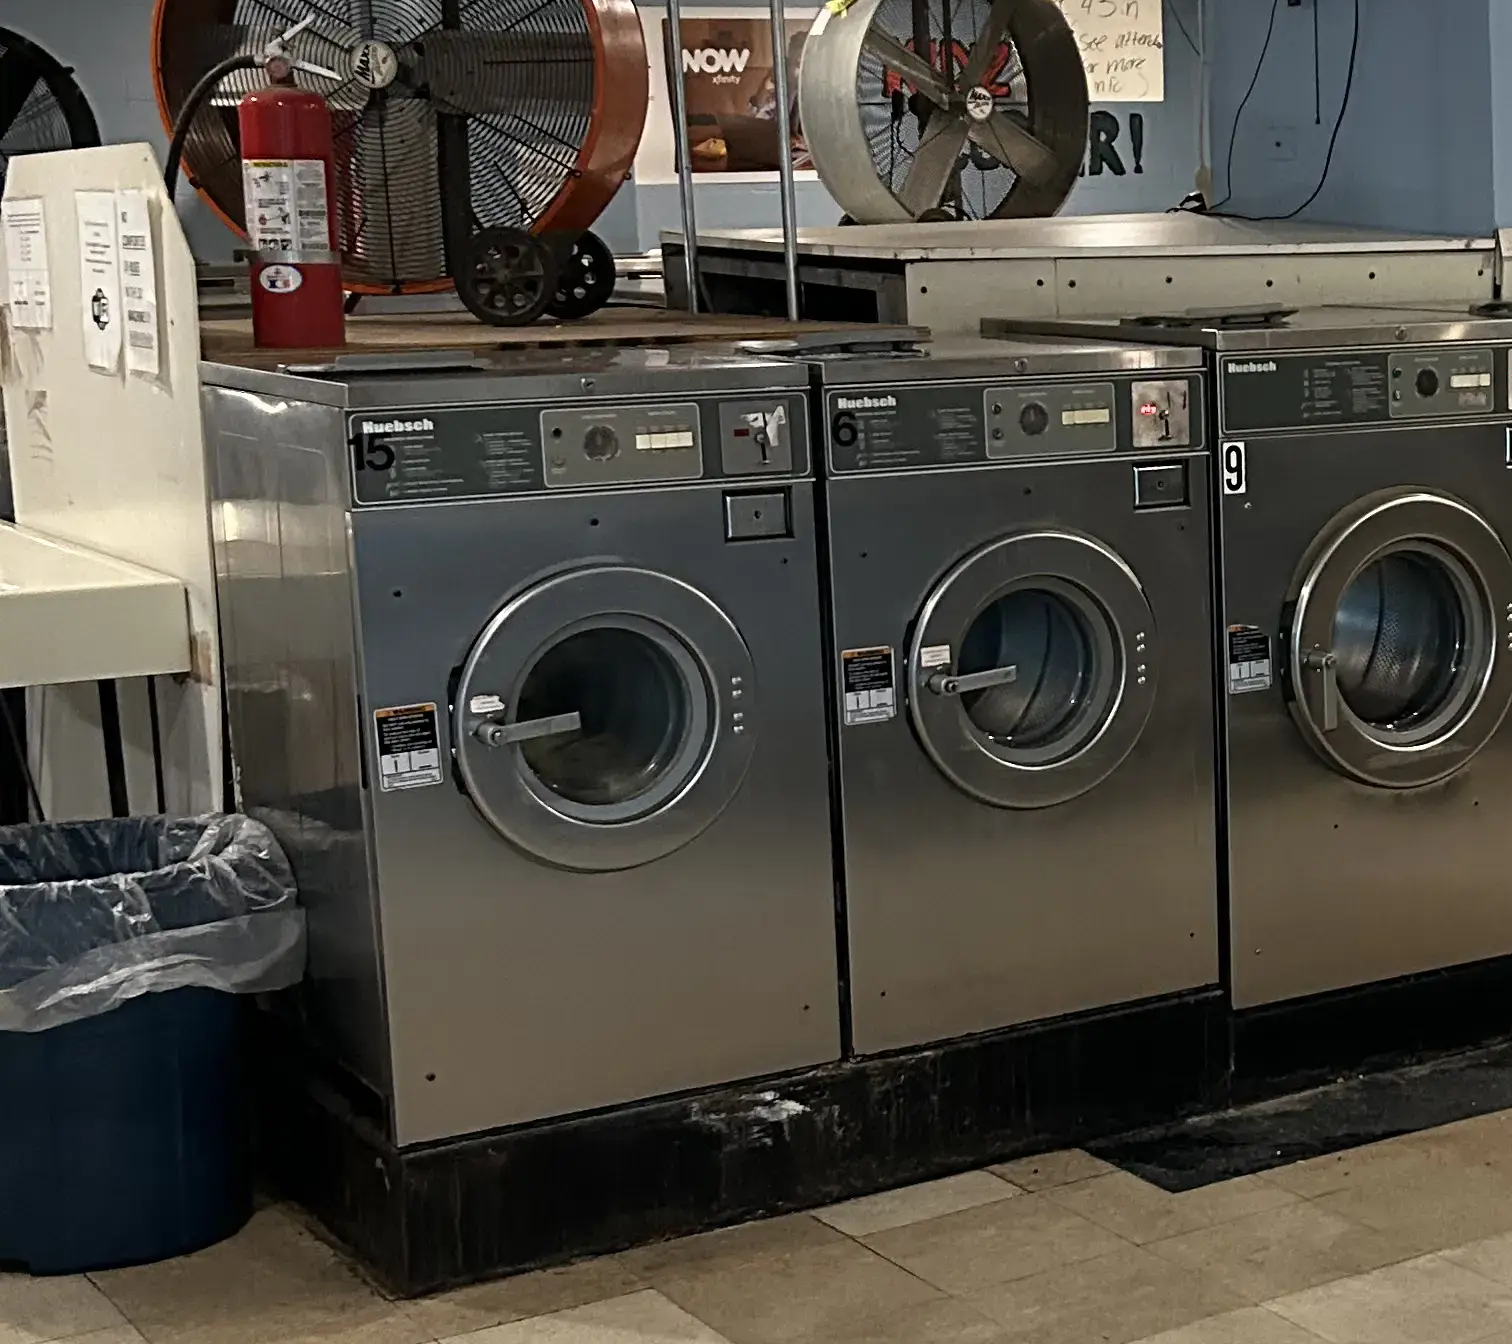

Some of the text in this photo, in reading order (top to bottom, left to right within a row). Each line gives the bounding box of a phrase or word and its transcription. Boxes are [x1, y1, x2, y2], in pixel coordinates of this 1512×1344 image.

[682, 48, 750, 73] NOW
[1228, 361, 1277, 373] Huebsch
[838, 395, 897, 409] Huebsch
[362, 418, 434, 434] Huebsch
[833, 411, 858, 447] 6
[347, 433, 395, 472] 15
[1225, 445, 1243, 491] 9
